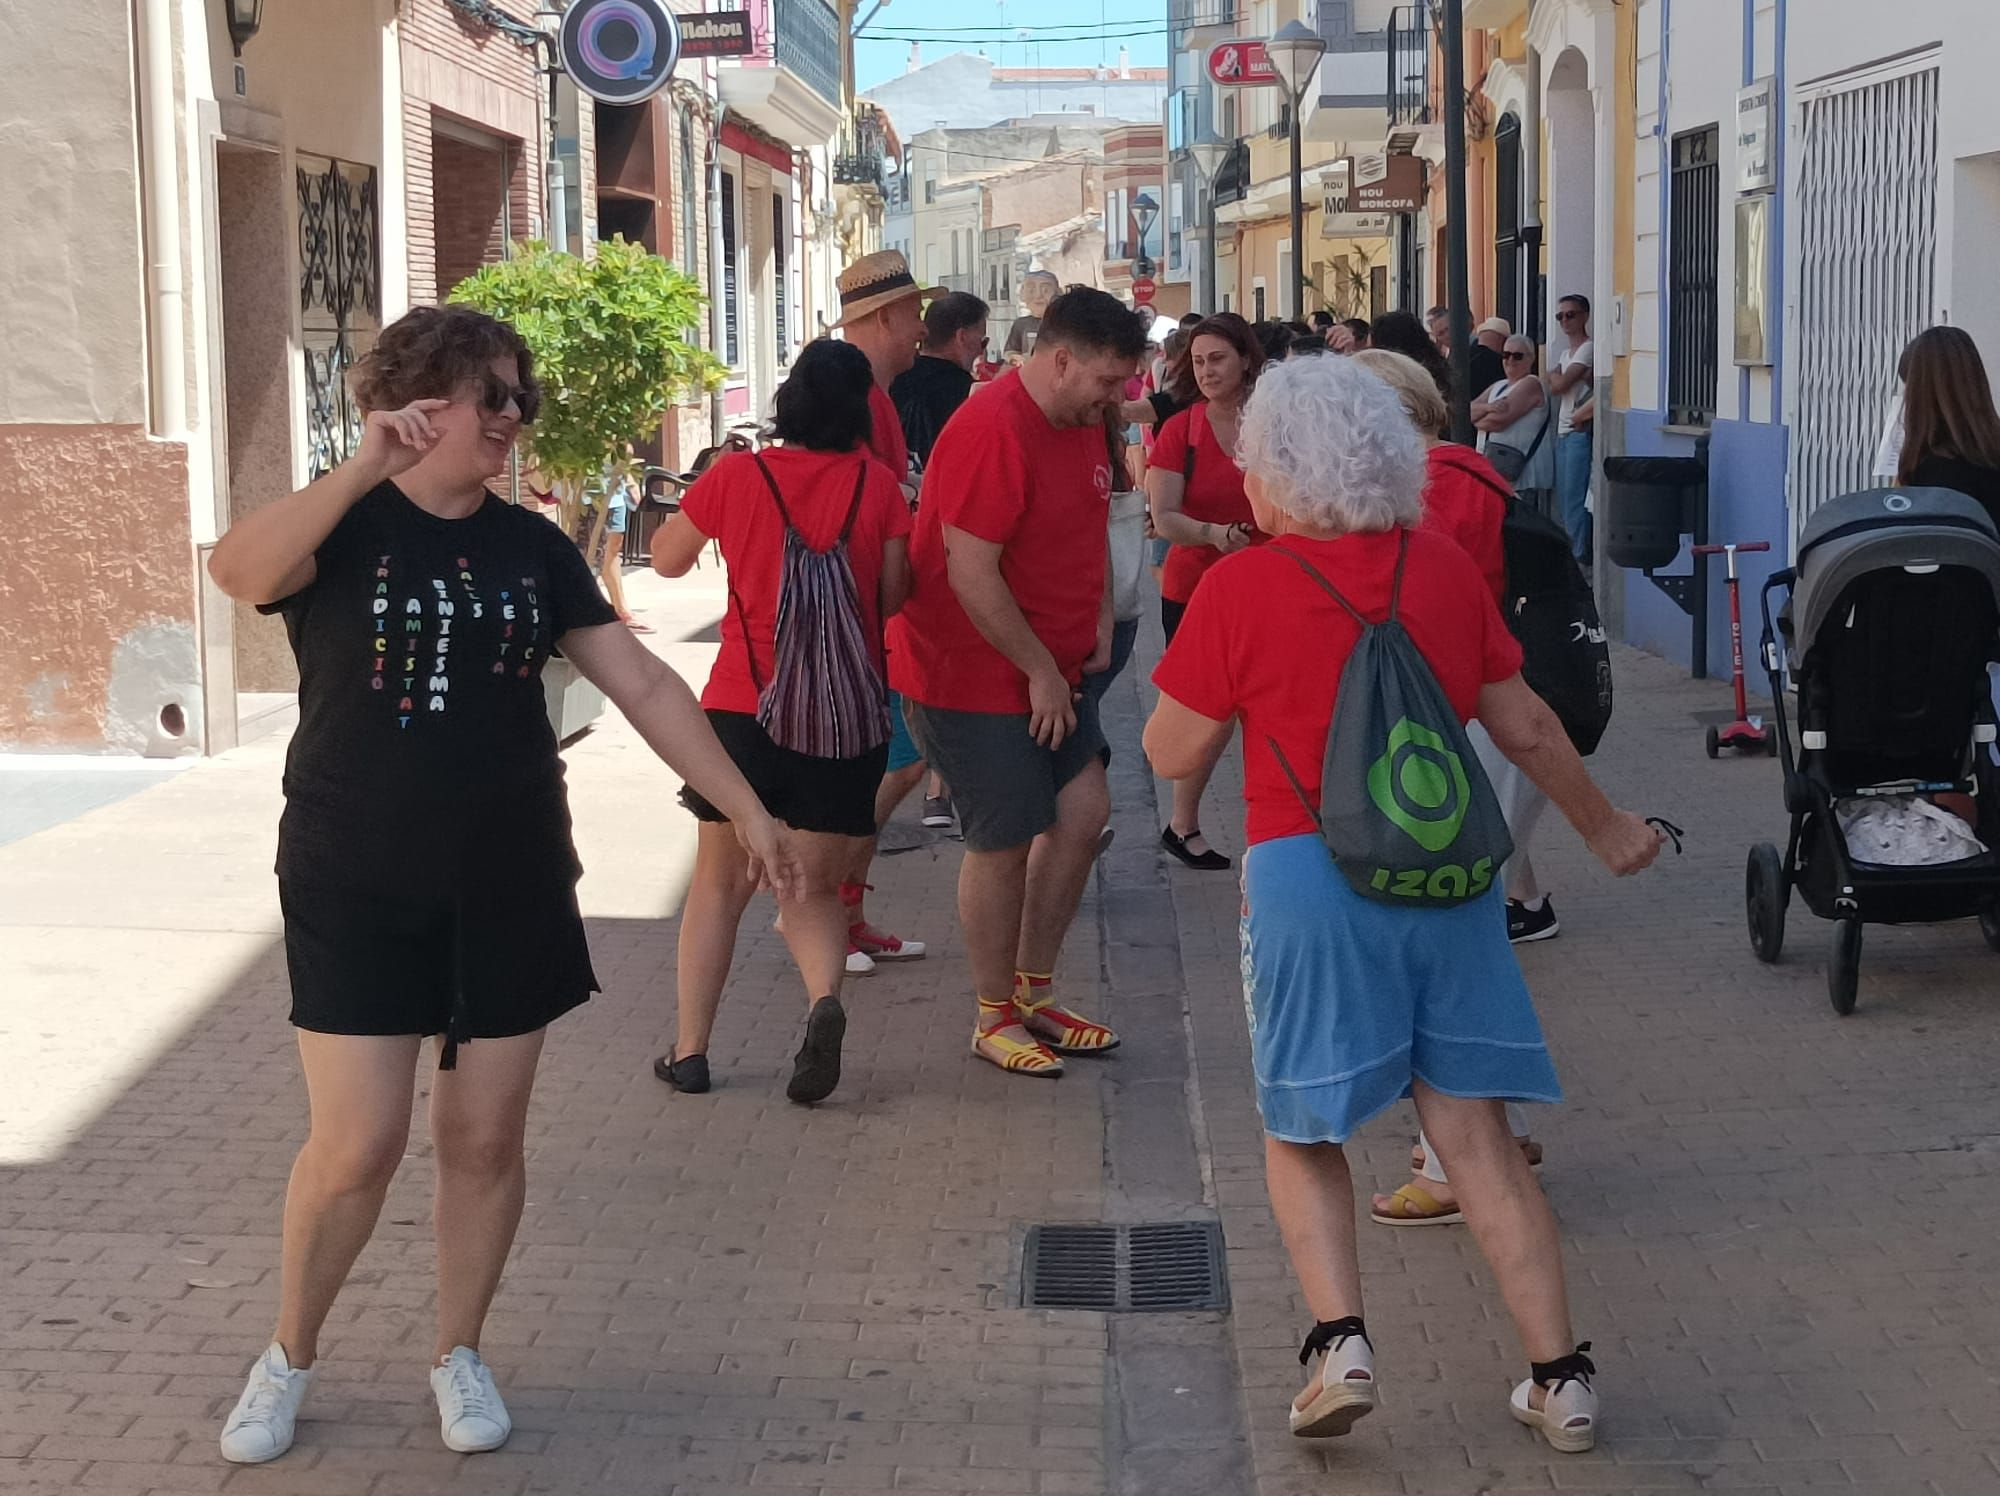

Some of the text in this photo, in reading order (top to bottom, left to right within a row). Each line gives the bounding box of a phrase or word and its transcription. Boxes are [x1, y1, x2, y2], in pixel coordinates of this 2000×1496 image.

[681, 19, 743, 39] Mahou
[1323, 181, 1343, 190] nou
[1359, 188, 1384, 198] NOU
[1359, 199, 1414, 209] MONCOFA
